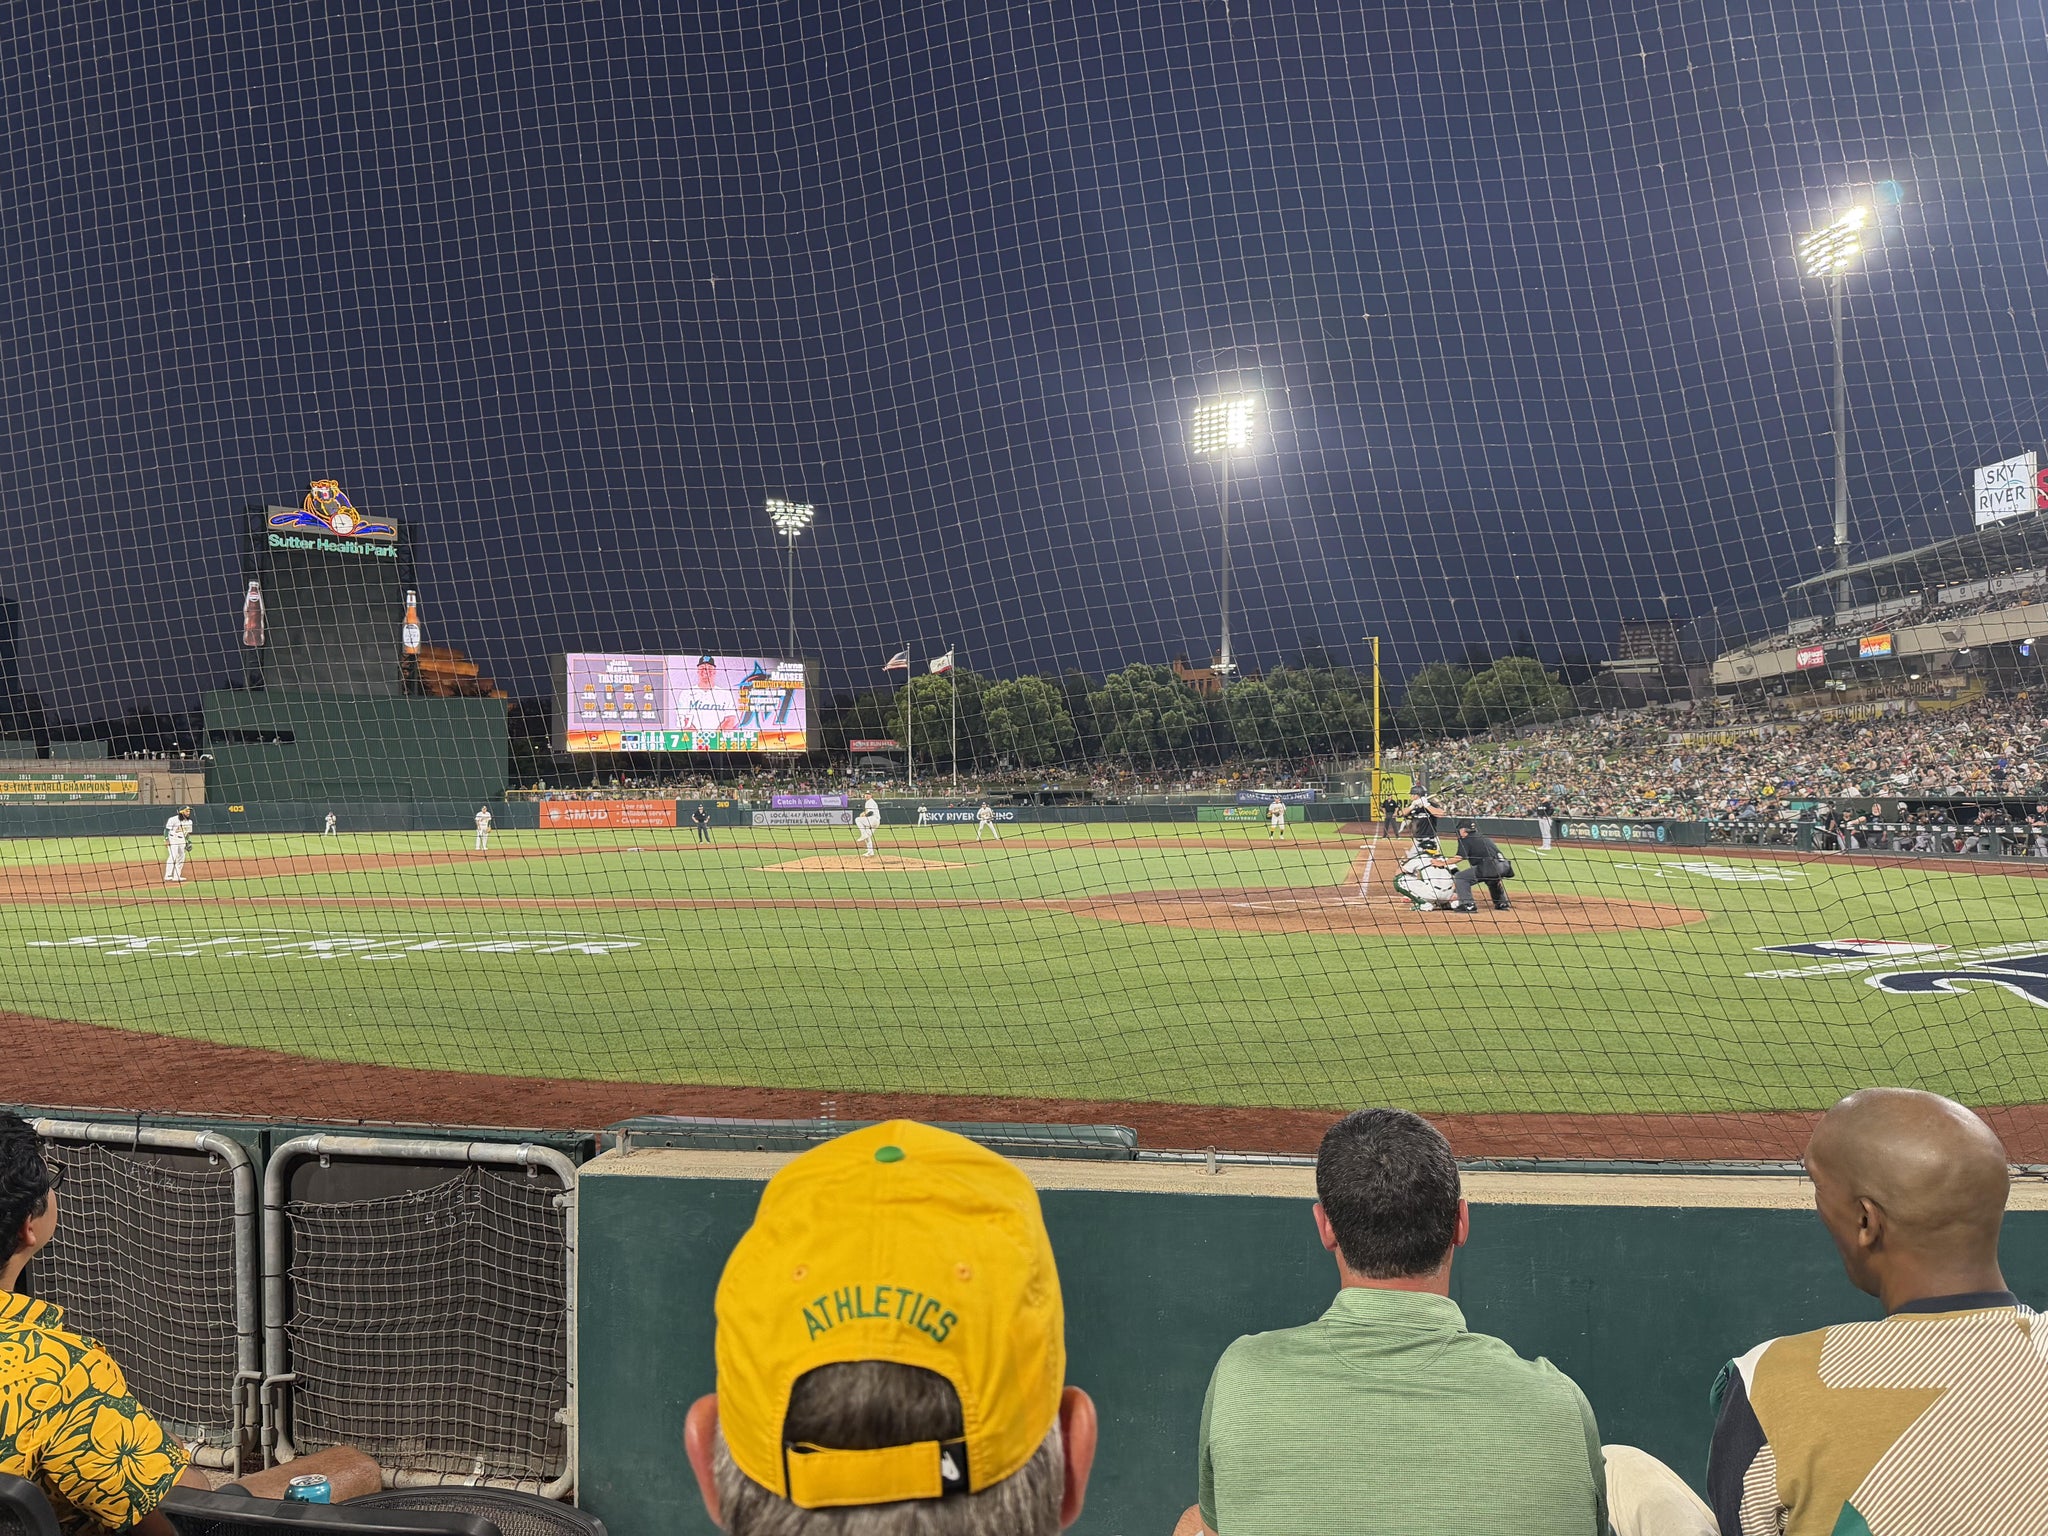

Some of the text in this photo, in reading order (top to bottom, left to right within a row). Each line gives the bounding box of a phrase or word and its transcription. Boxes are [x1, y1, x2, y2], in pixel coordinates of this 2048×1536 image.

[1987, 463, 2016, 484] SKY
[1980, 486, 2026, 510] RIVER
[268, 534, 398, 558] Sutter Health Park
[690, 700, 726, 710] Miami
[671, 735, 679, 748] 7
[34, 782, 61, 792] WORLD
[63, 782, 110, 792] CHAMPIONS
[564, 809, 608, 820] SMUD
[926, 812, 944, 820] SKY
[947, 812, 974, 820] RIVER
[802, 1285, 958, 1344] ATHLETICS
